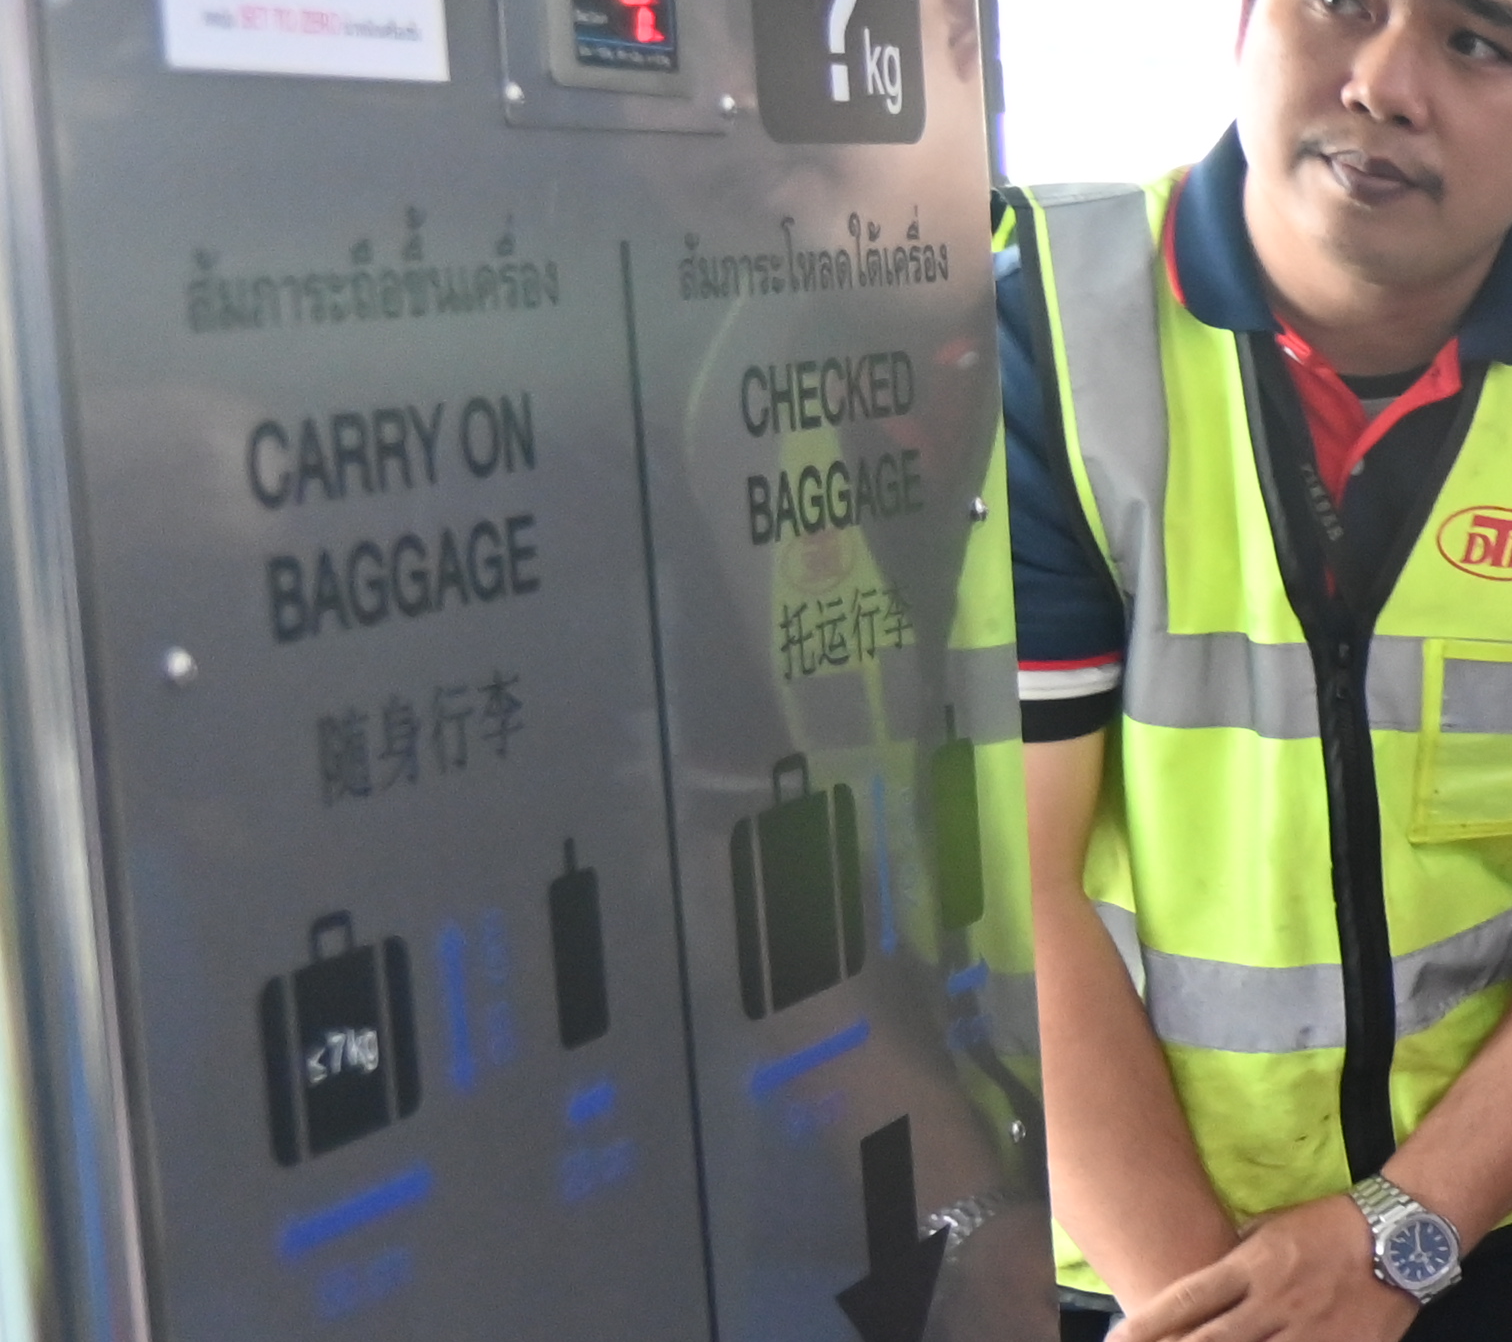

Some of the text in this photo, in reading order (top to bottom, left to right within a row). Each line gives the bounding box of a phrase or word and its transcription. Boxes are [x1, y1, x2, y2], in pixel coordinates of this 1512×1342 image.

[863, 37, 903, 115] kg
[679, 206, 950, 302] สัมภาระโหลดใต้เครื่อง
[740, 349, 914, 440] CHECKED
[247, 392, 536, 509] CARRY ON
[745, 446, 924, 546] BAGGAGE
[266, 514, 540, 644] BAGGAGE
[777, 581, 914, 681] 托运行李
[316, 670, 523, 809] 随身行李
